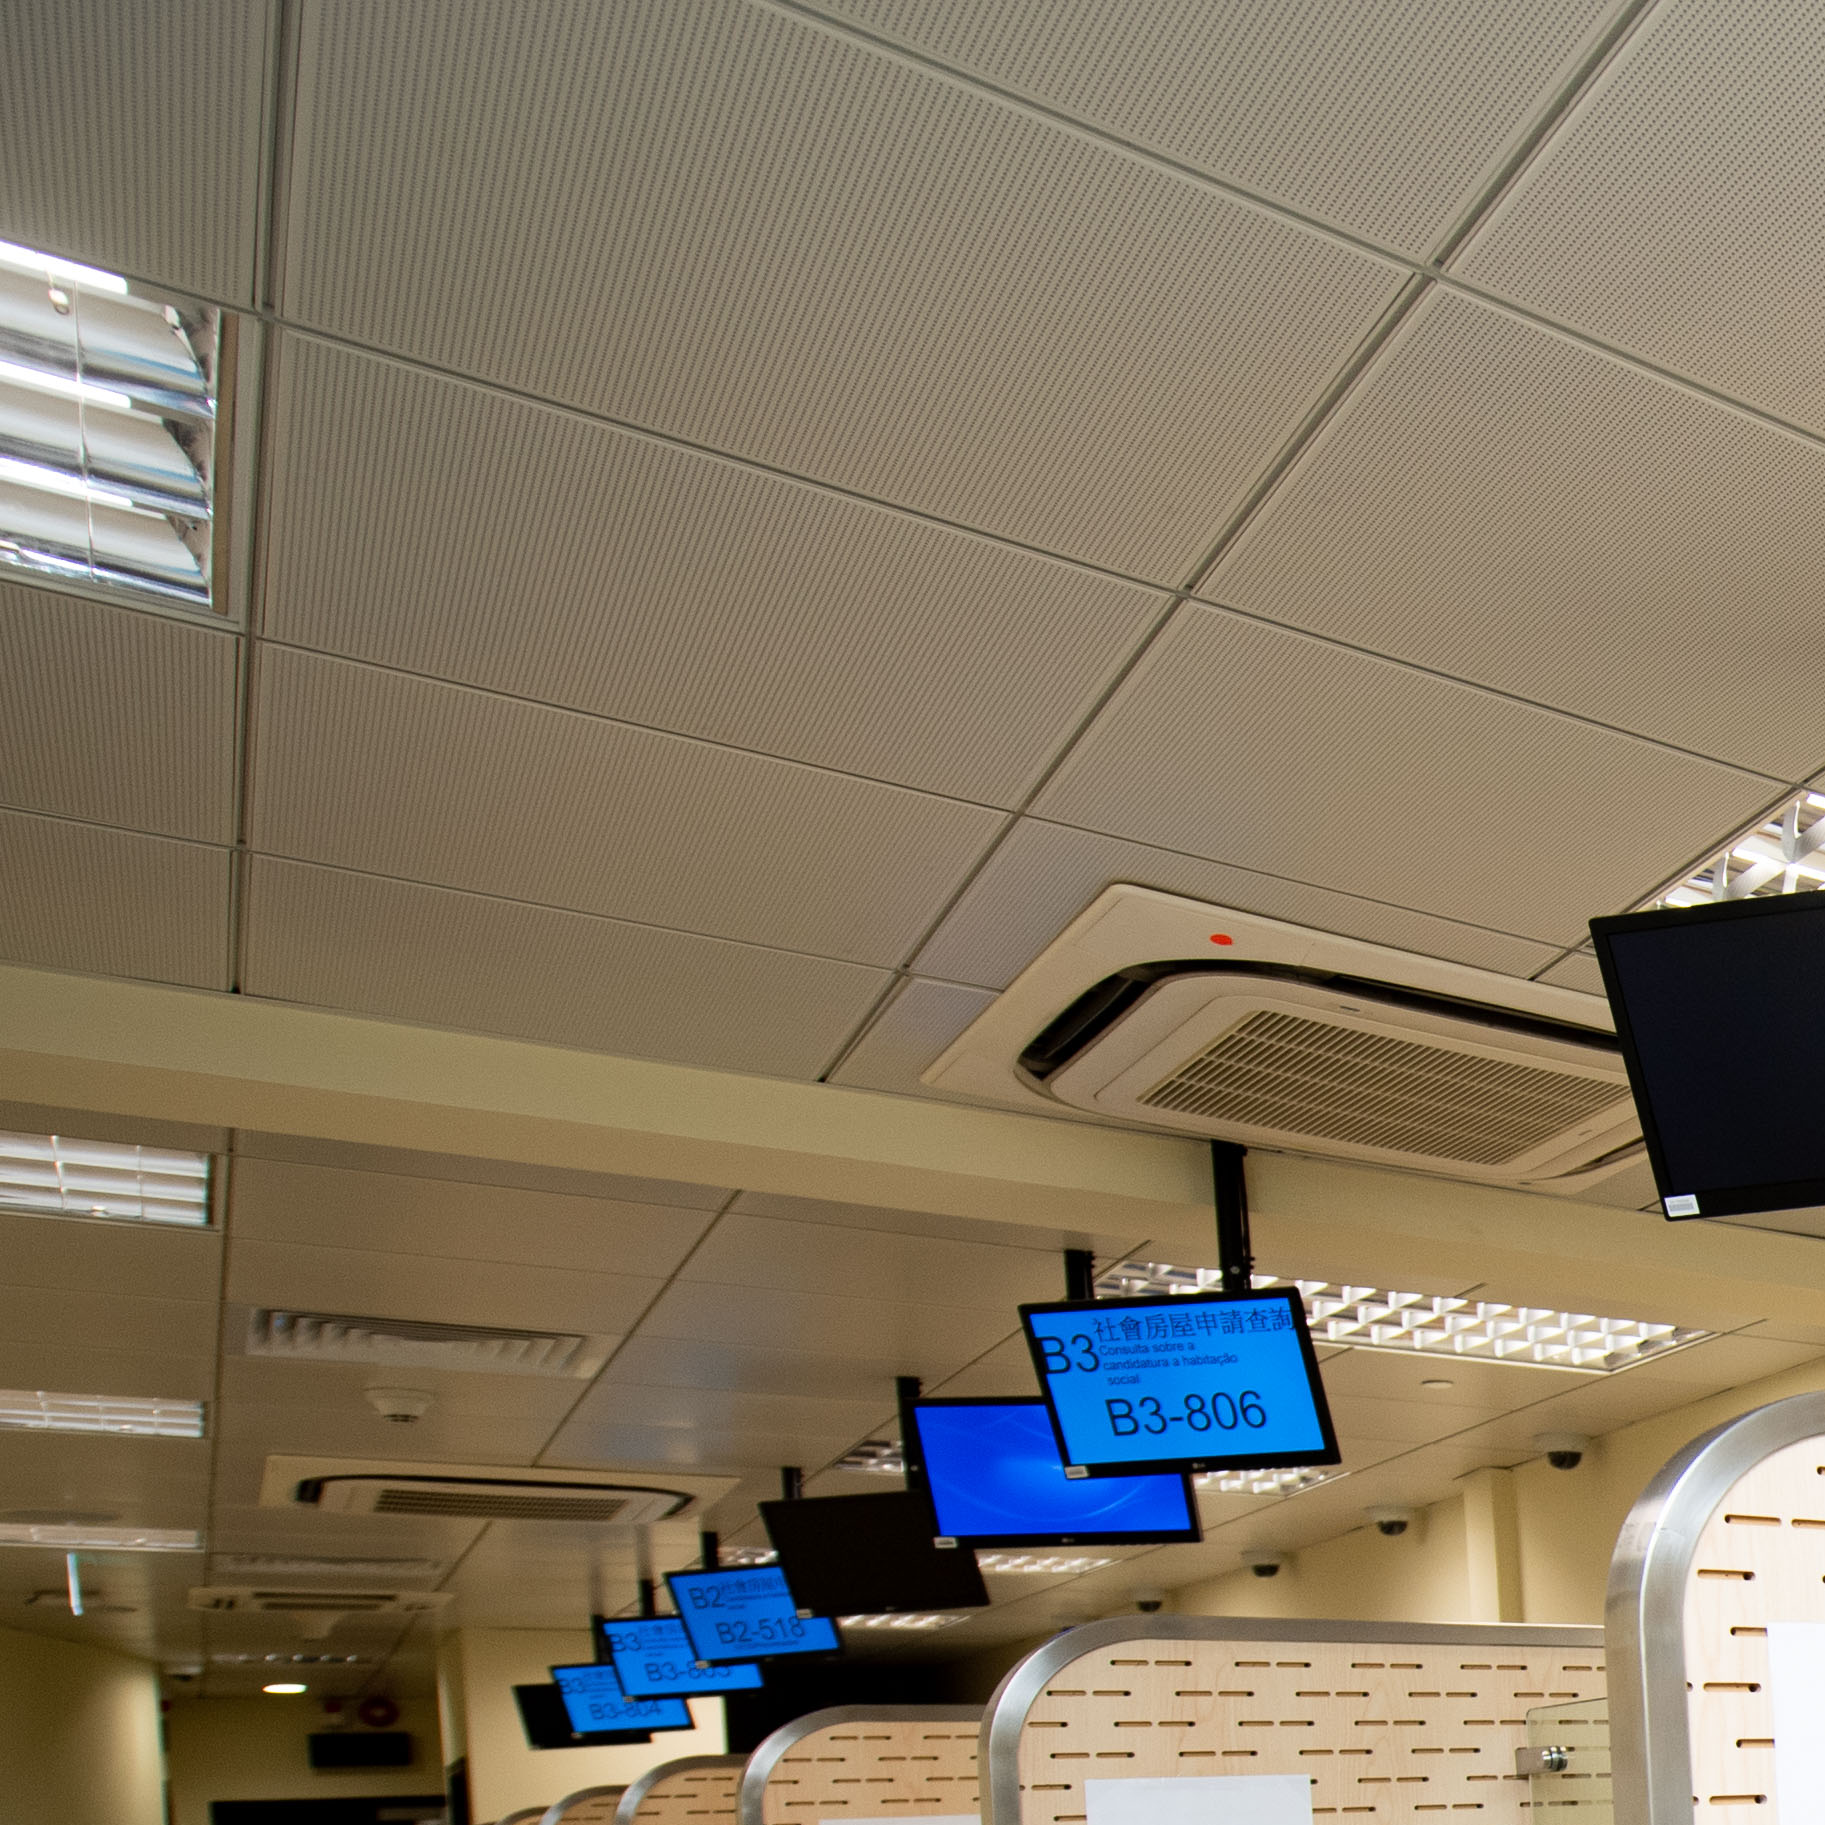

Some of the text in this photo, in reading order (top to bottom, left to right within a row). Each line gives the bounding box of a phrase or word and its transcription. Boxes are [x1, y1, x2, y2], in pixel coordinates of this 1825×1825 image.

[1100, 1343, 1150, 1357] Consulta
[1152, 1341, 1184, 1353] sobre
[1103, 1355, 1169, 1371] candidatura
[1182, 1352, 1239, 1367] habitação
[1107, 1373, 1141, 1386] social
[1105, 1389, 1268, 1437] B3-806
